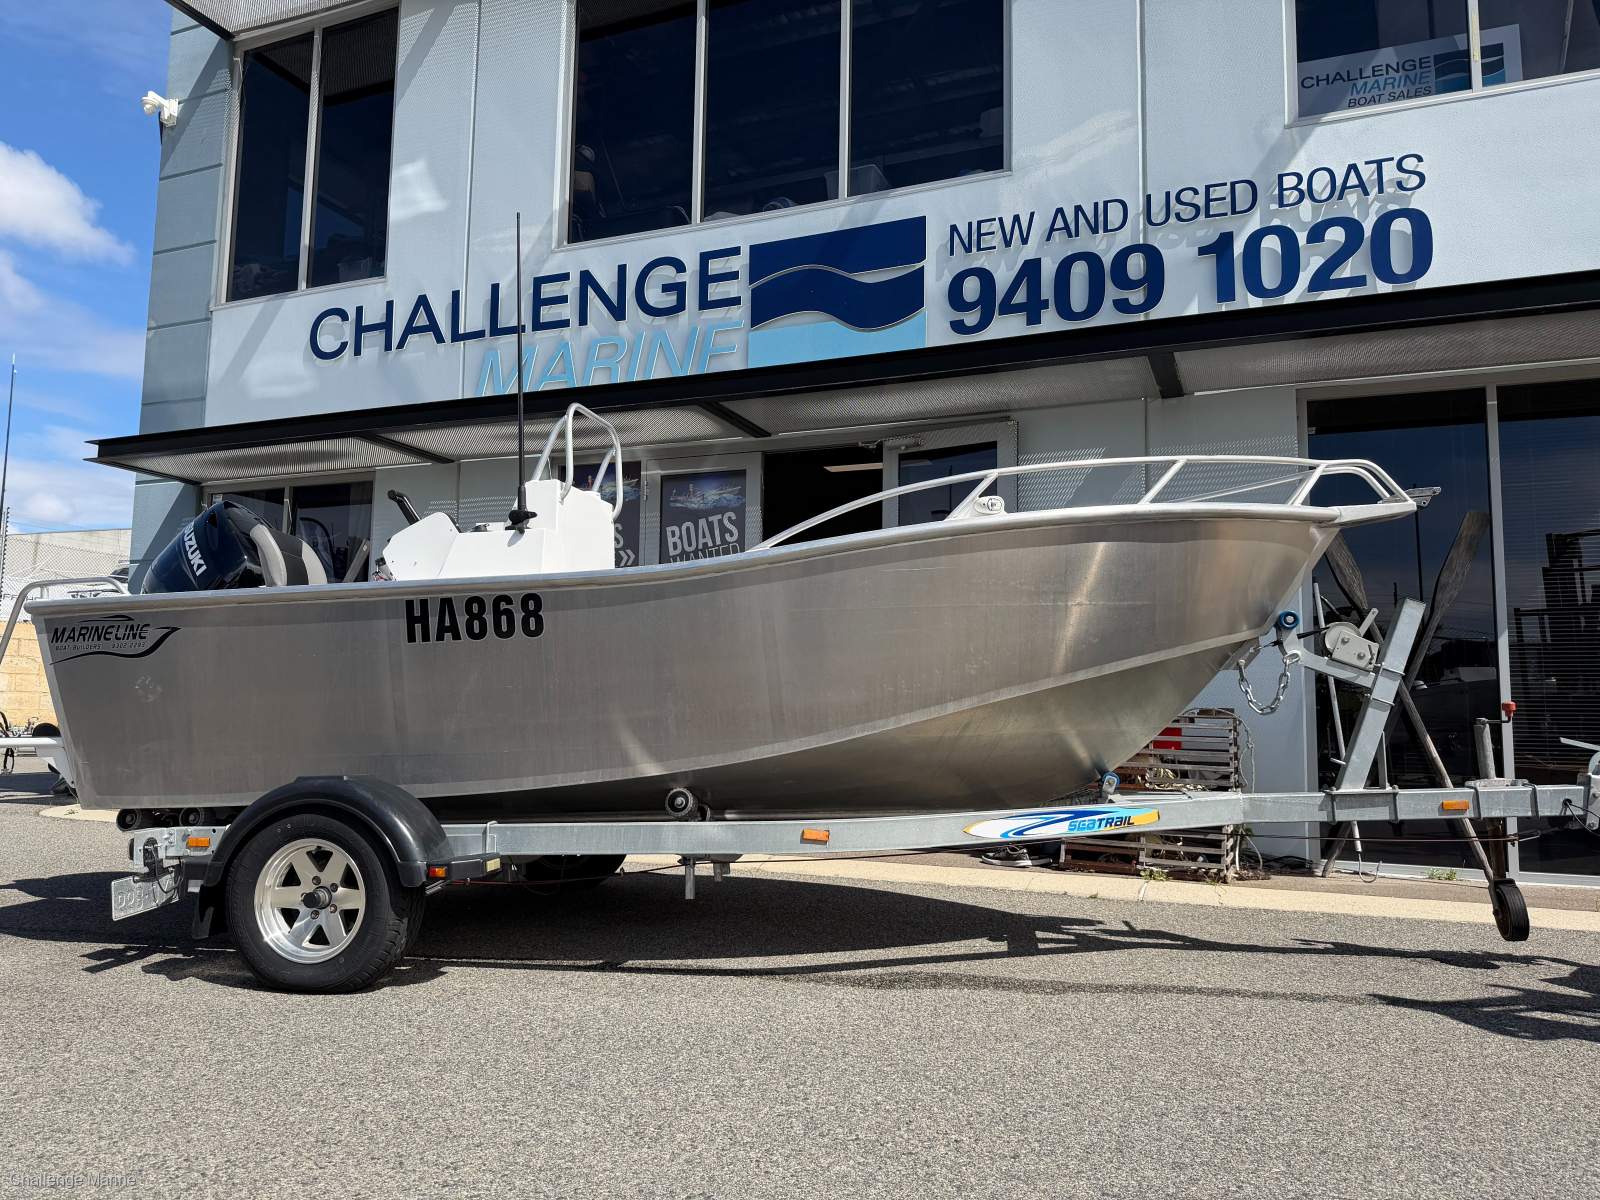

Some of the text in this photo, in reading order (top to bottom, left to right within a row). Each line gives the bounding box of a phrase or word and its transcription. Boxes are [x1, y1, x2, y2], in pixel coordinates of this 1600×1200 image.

[1300, 55, 1433, 90] CHALLENGE
[1347, 85, 1432, 109] BOAT SALES
[1350, 70, 1432, 97] MARINE
[948, 152, 1427, 257] NEW AND USED BOATS
[946, 206, 1434, 337] 9409 1020
[308, 245, 743, 362] CHALLENGE
[476, 319, 745, 398] MARINE
[665, 511, 739, 557] BOATS
[50, 623, 151, 644] MARINELINE
[404, 592, 545, 644] HA868
